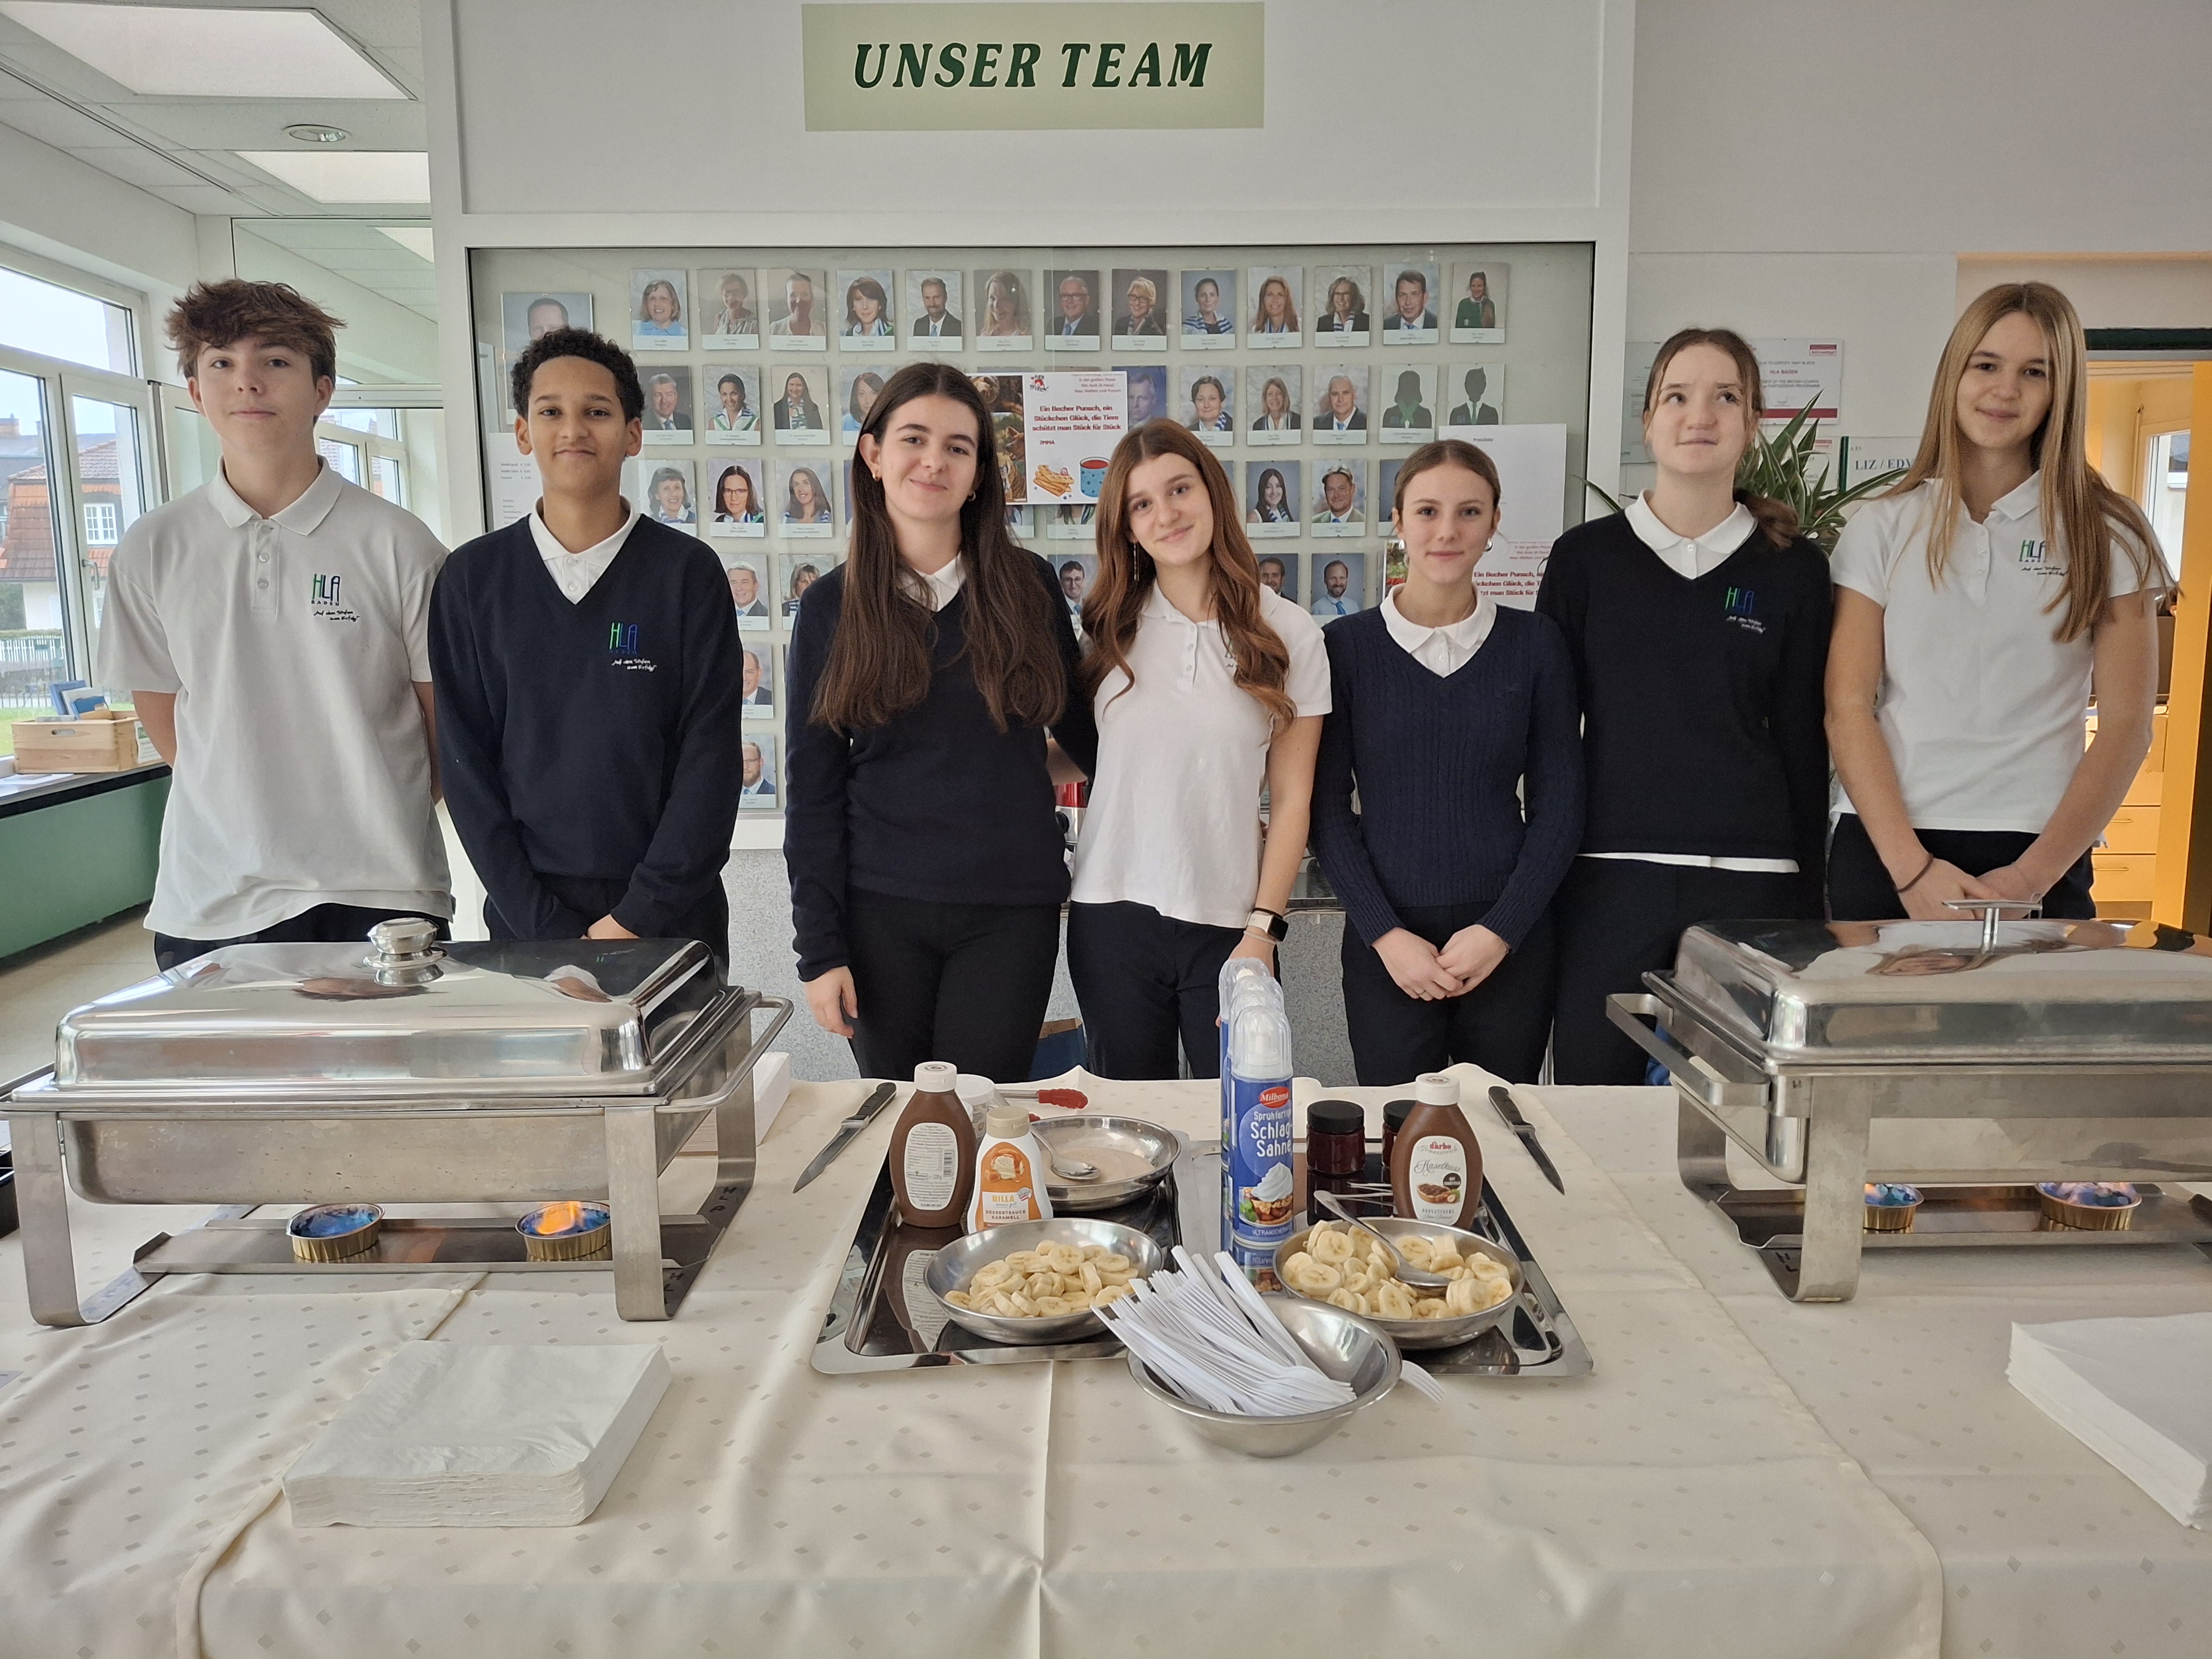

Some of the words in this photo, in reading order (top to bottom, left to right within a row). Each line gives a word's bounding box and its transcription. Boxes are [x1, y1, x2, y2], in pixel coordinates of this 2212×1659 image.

[854, 42, 1041, 88] UNSER
[1061, 42, 1213, 88] TEAM
[1855, 459, 1877, 470] LIZ
[1880, 460, 1885, 470] /
[312, 573, 340, 602] HLA
[609, 622, 638, 650] HLA
[1250, 1121, 1293, 1139] Schlag-
[1256, 1139, 1291, 1157] Sahne
